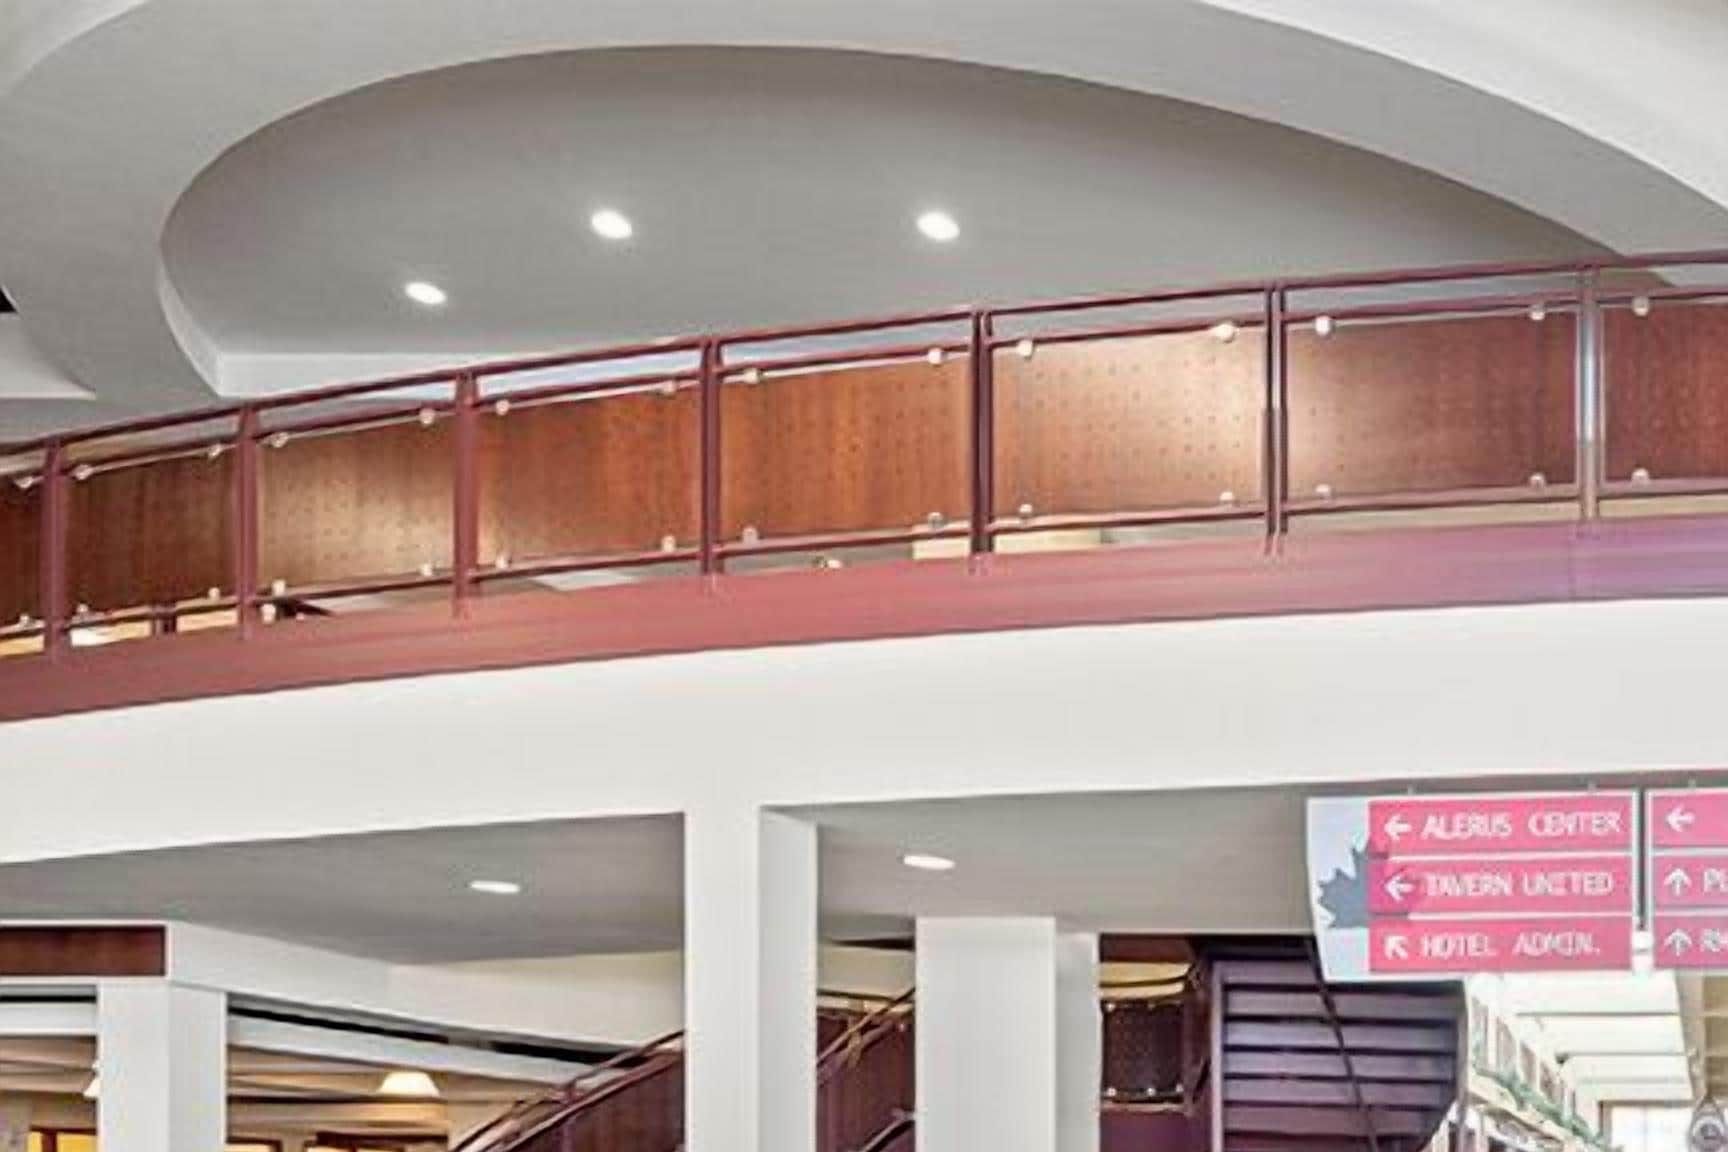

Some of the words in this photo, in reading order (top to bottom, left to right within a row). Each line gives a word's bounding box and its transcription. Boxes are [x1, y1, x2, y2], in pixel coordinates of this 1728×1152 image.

[1420, 811, 1512, 841] ALERUS
[1528, 810, 1622, 837] CENTER
[1424, 871, 1513, 897] TAVERN
[1522, 870, 1613, 896] UNITED
[1421, 932, 1497, 957] HOTEL
[1513, 930, 1601, 956] ADMIN.
